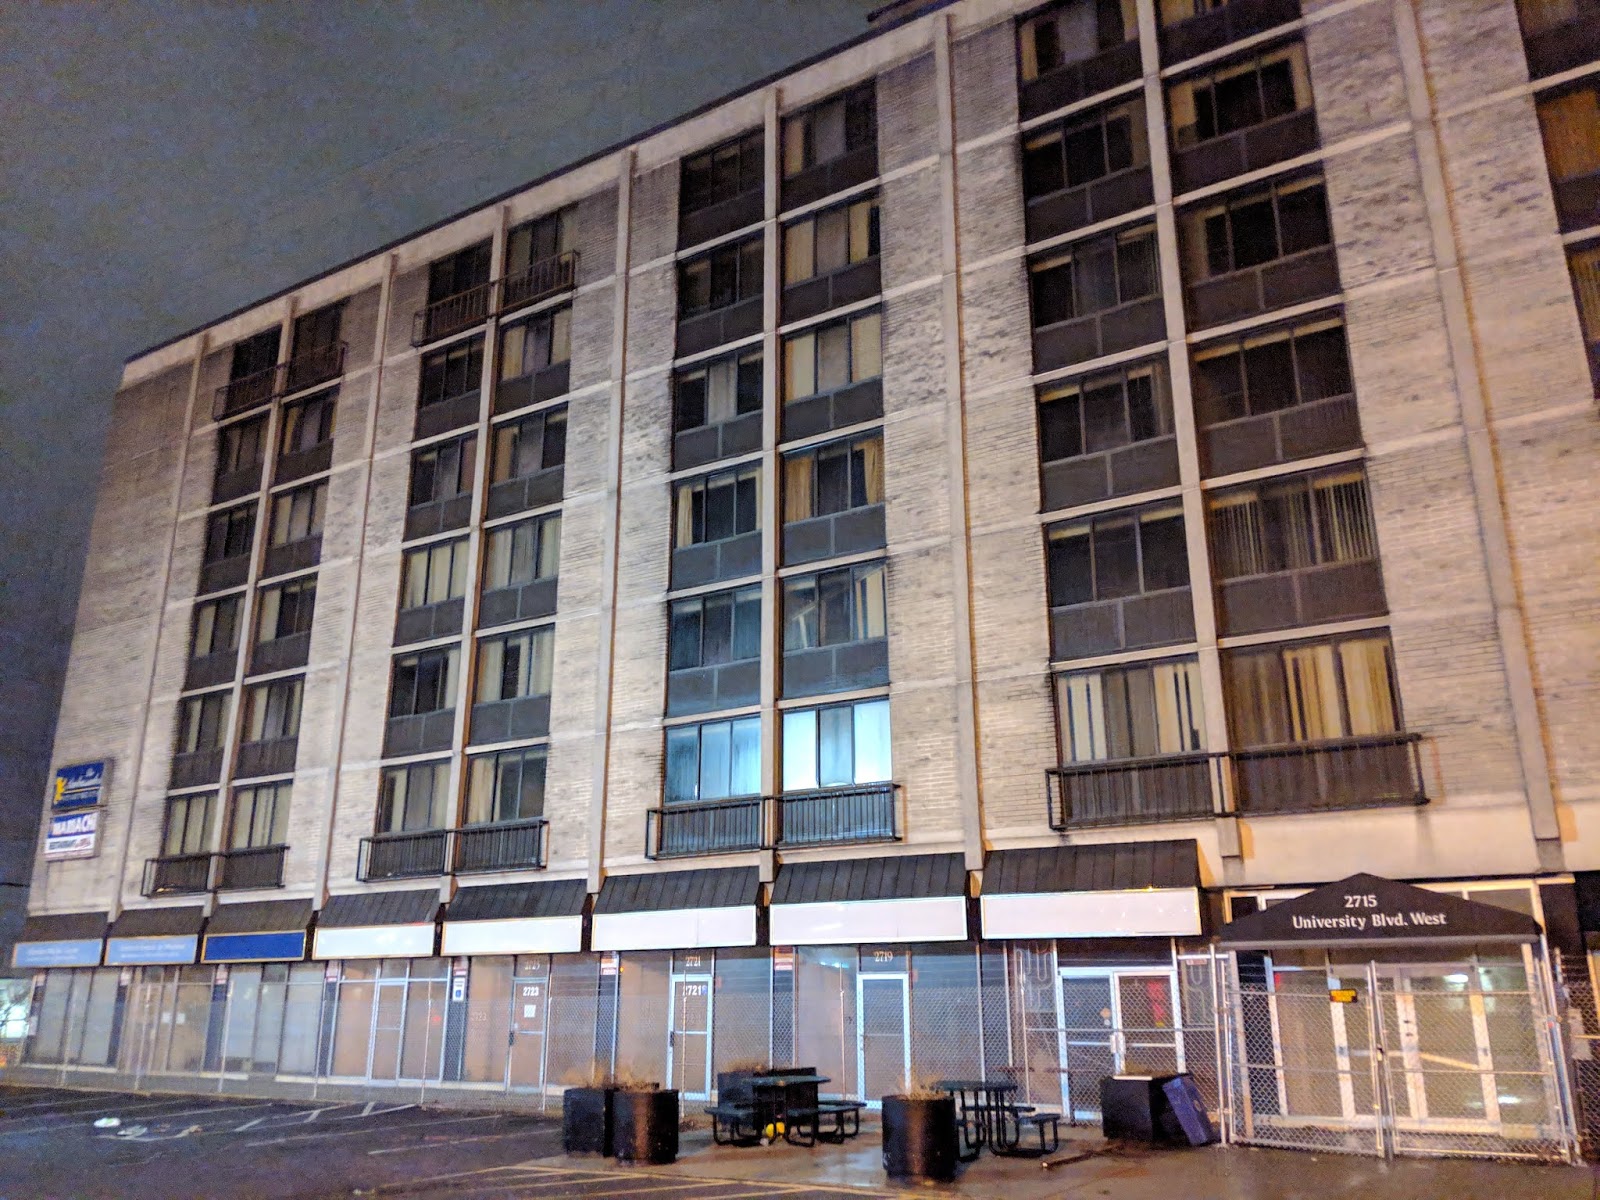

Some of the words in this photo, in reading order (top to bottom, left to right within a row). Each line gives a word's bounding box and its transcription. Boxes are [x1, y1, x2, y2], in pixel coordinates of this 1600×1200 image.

[1343, 894, 1378, 908] 2715
[1292, 914, 1366, 930] University
[1371, 912, 1408, 927] Blvd.
[1409, 911, 1447, 926] West
[873, 950, 894, 962] 2719
[522, 986, 540, 997] 2723
